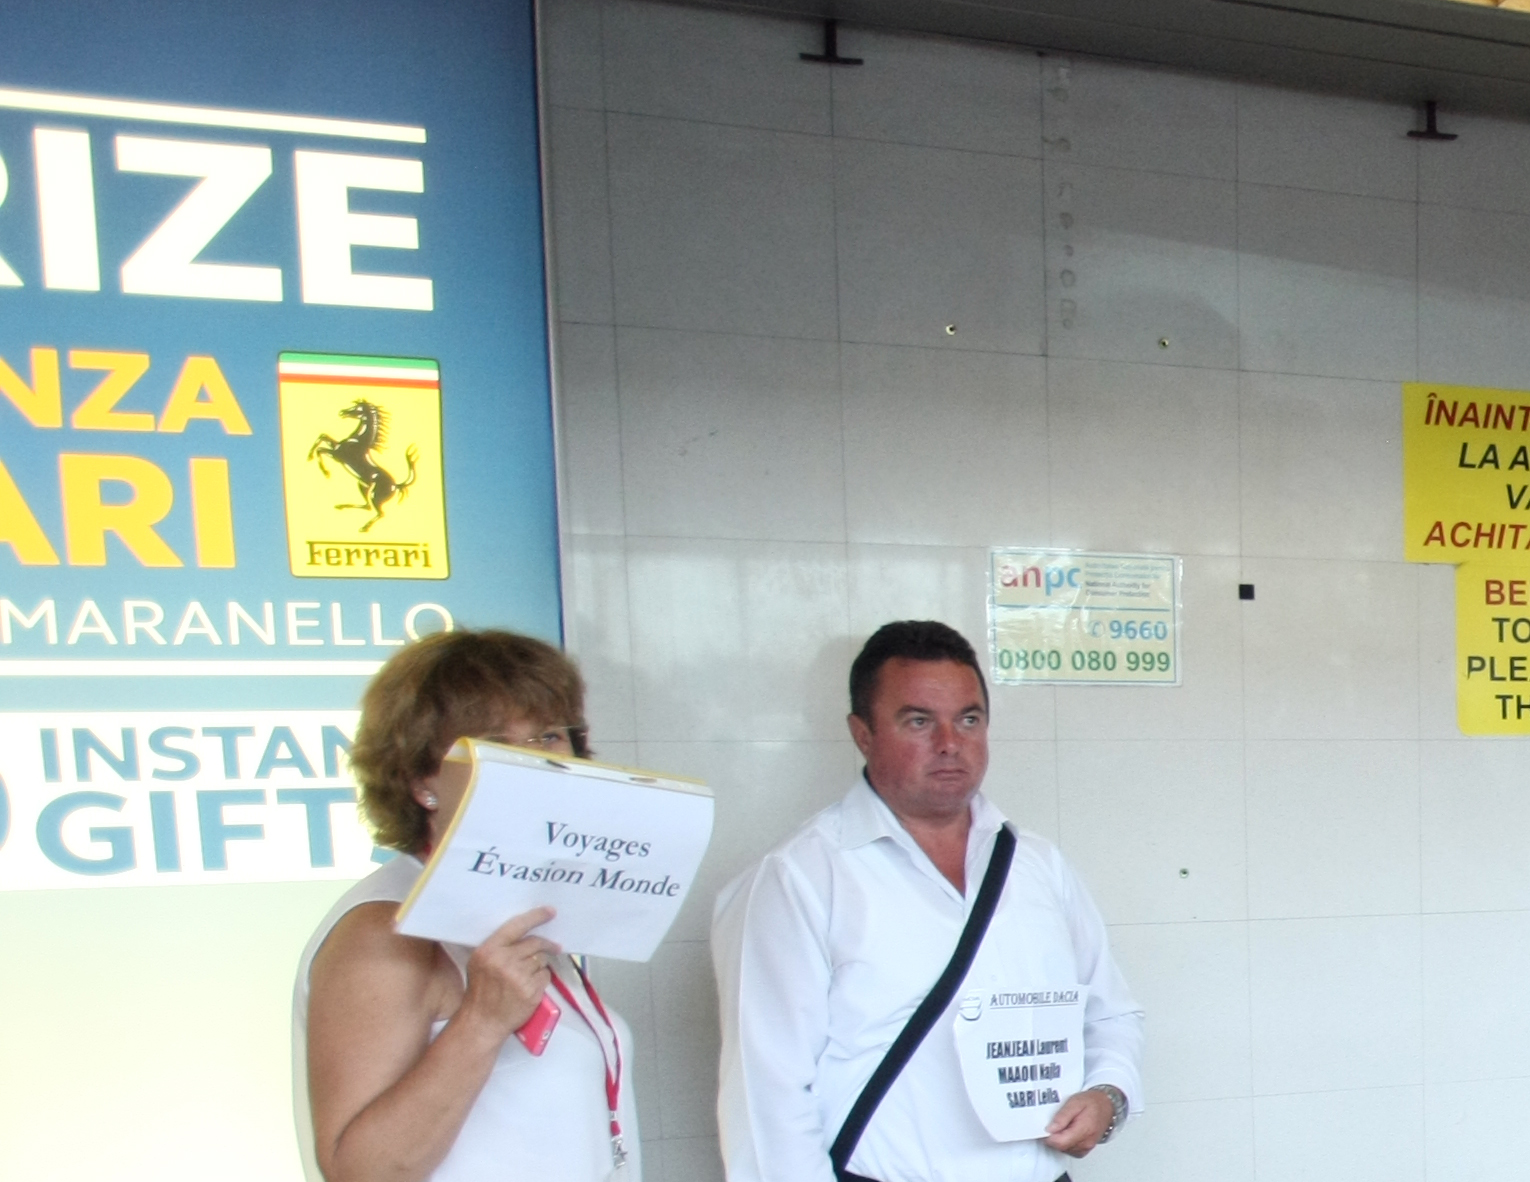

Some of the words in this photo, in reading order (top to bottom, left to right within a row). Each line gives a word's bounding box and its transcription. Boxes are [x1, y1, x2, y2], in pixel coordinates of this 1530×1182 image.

[0, 124, 434, 311] IZE
[1458, 442, 1500, 470] LA
[306, 540, 432, 568] Ferrari
[1000, 564, 1081, 597] anpc
[0, 597, 455, 645] MARANELLO
[1109, 620, 1168, 640] 9660
[1000, 649, 1061, 670] 0800
[1071, 650, 1117, 671] 080
[1126, 651, 1171, 672] 999
[36, 785, 400, 877] GIFT
[546, 821, 651, 861] Voyages
[468, 846, 584, 885] Évasion
[591, 868, 680, 897] Monde
[990, 992, 1051, 1006] AUTOMOBILE
[1053, 990, 1079, 1003] DACIA
